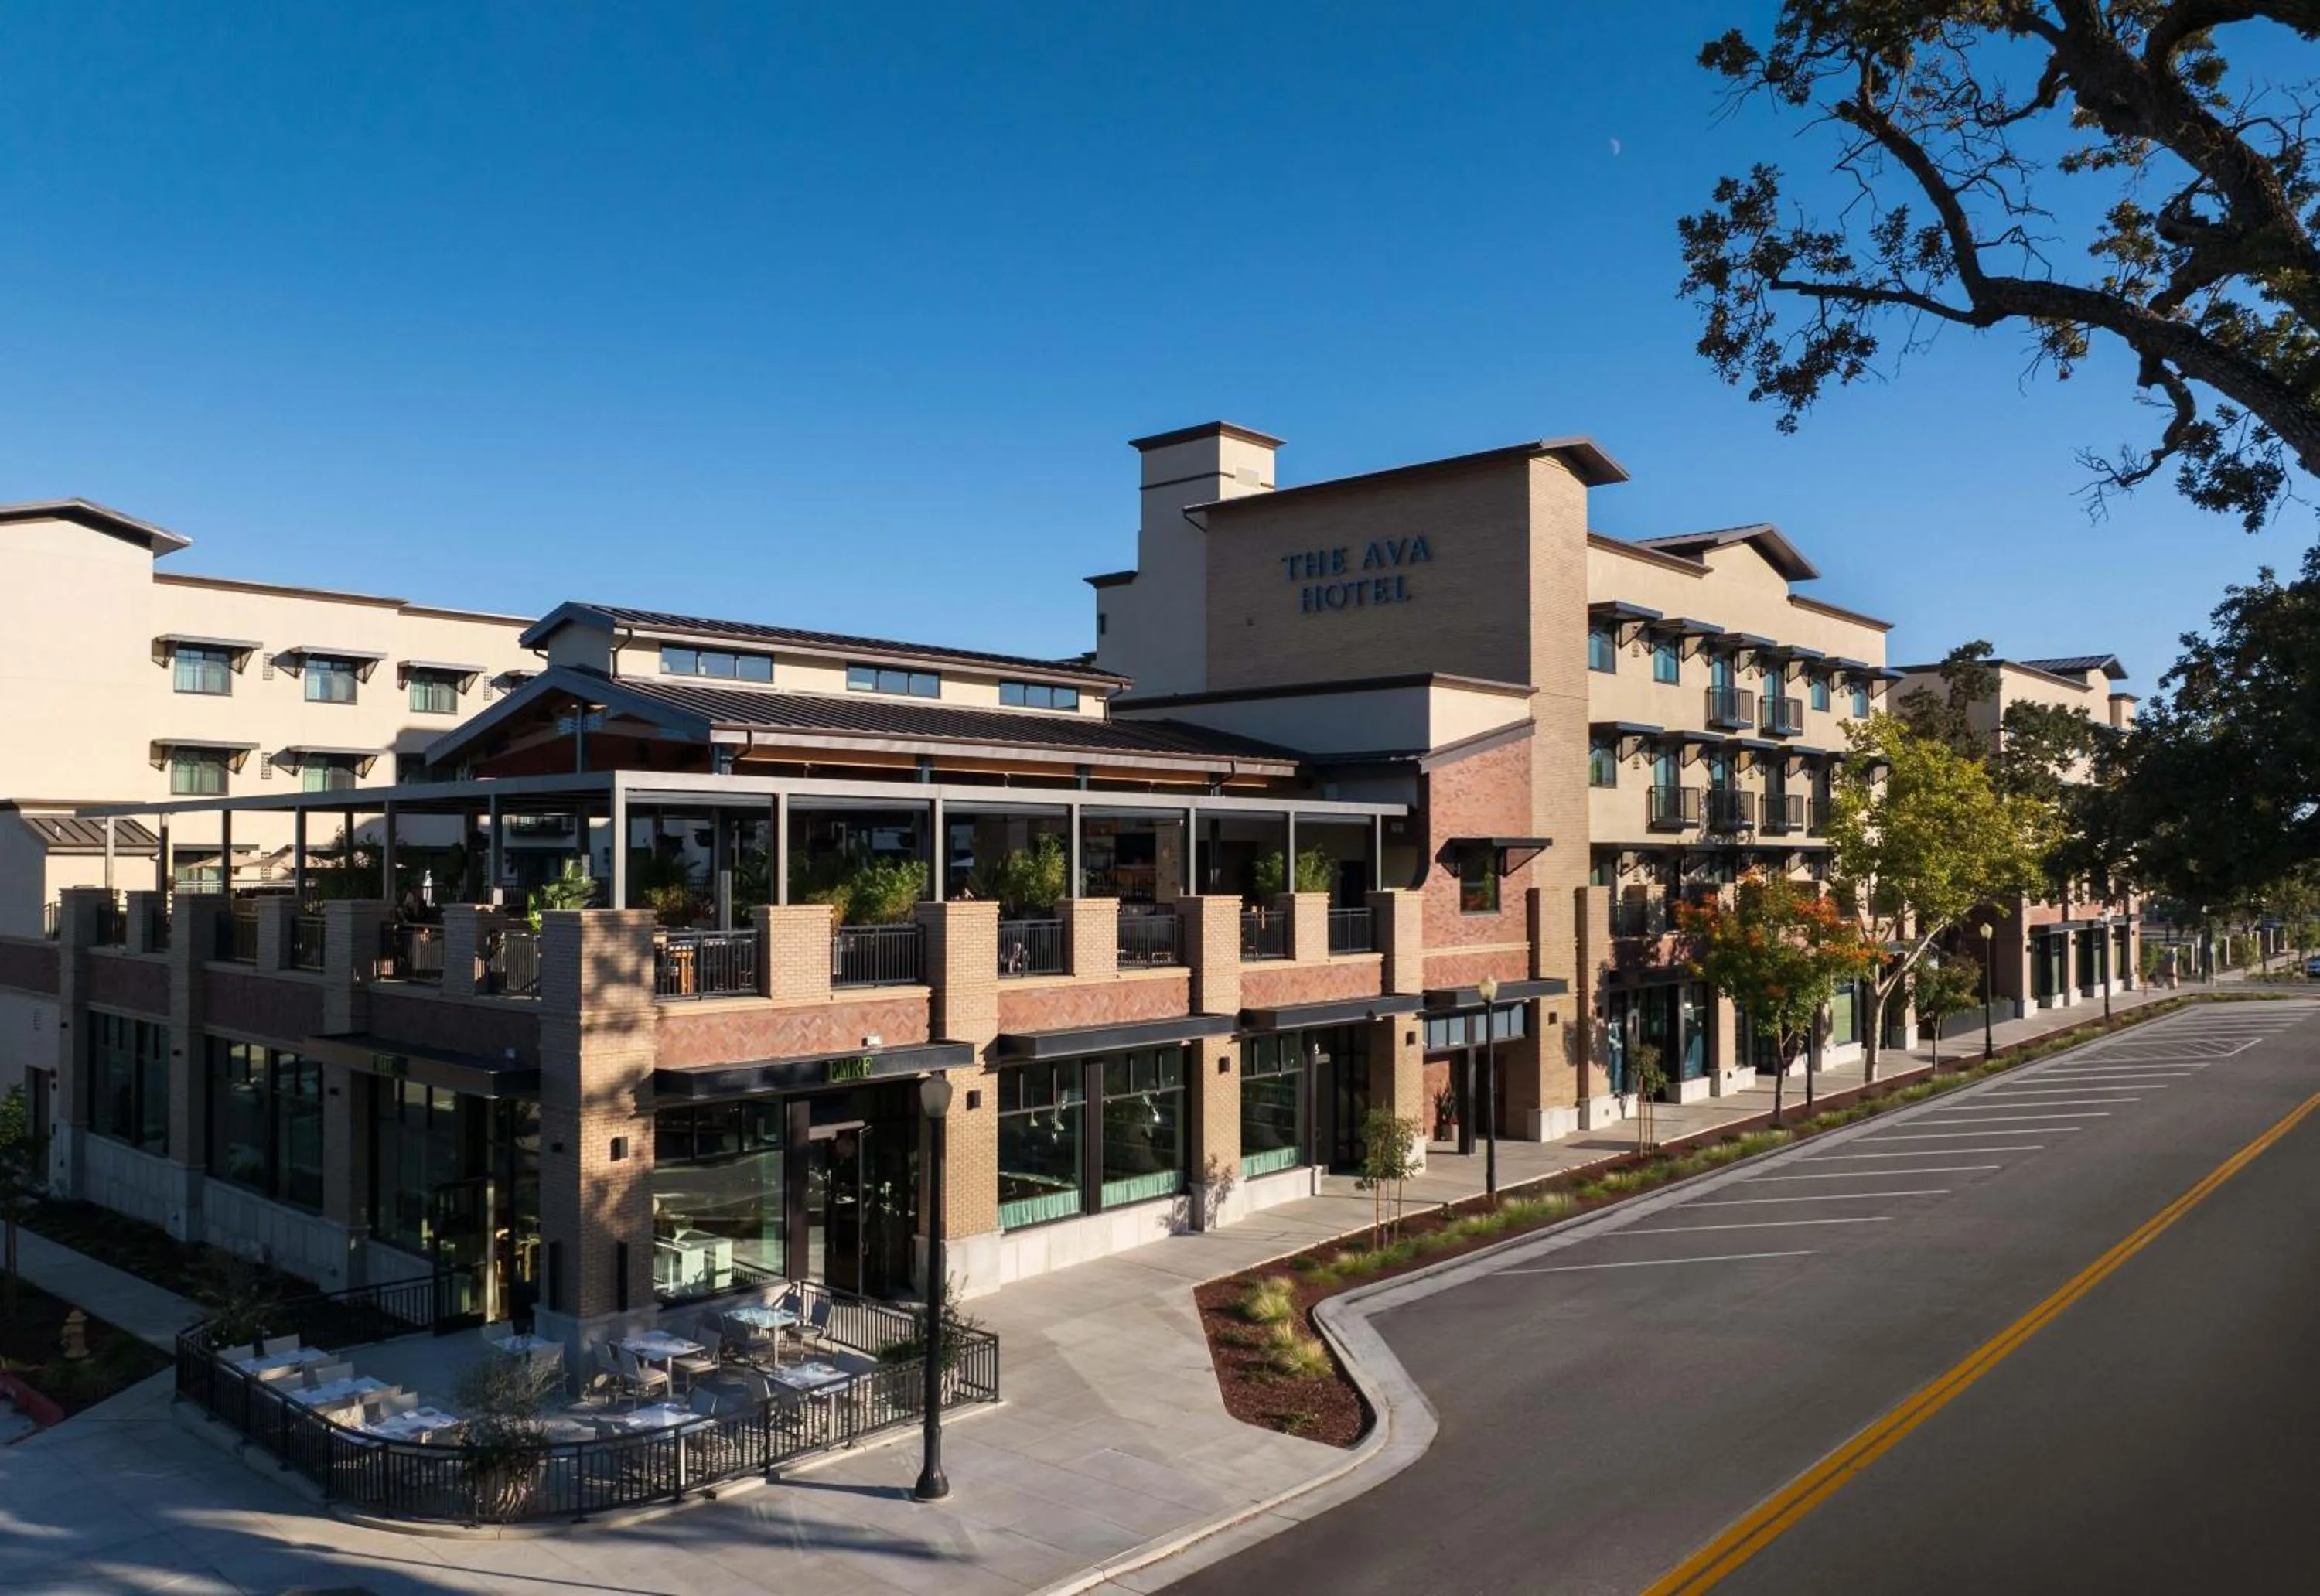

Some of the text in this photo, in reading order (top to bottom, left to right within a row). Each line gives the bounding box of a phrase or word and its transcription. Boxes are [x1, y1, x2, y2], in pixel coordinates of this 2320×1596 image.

[1281, 534, 1434, 581] THE AVA
[1298, 575, 1412, 614] HOTEL
